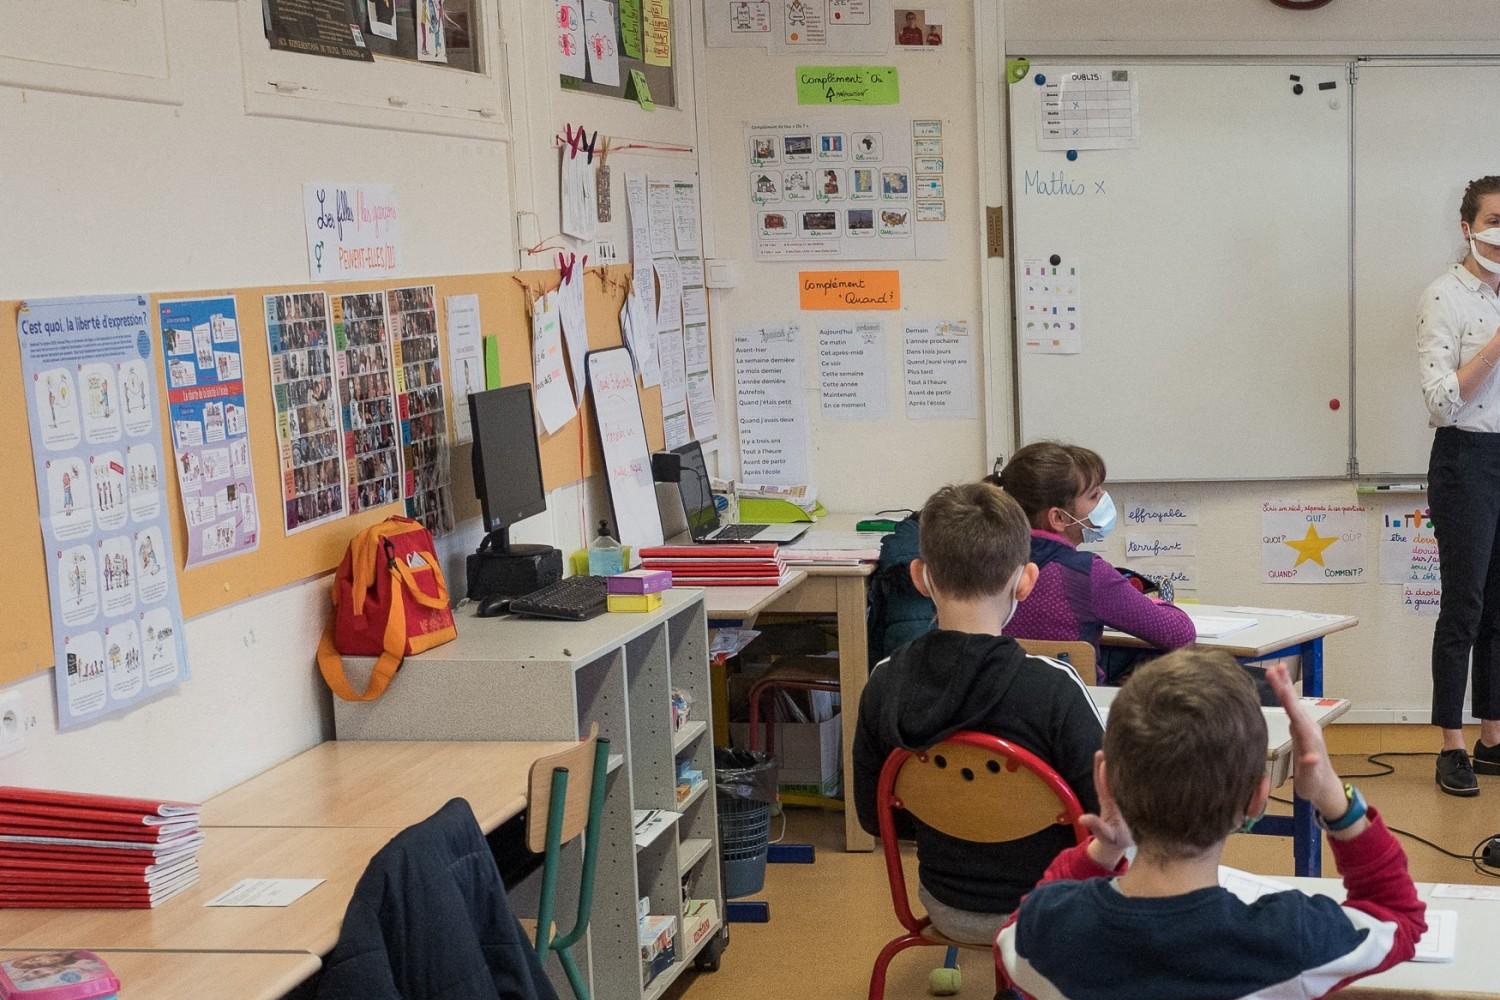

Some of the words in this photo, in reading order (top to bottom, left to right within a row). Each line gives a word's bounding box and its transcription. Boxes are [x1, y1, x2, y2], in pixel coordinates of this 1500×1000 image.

[1024, 170, 1085, 195] Mathis
[66, 317, 74, 331] la
[75, 316, 100, 331] liberté
[1128, 508, 1187, 524] effroyable
[1305, 513, 1327, 523] QUI?
[1263, 534, 1287, 544] QUOI?
[1128, 539, 1183, 556] terrifiant
[1268, 569, 1298, 578] QUAND?
[1415, 588, 1440, 596] droite
[1414, 598, 1440, 611] gauche
